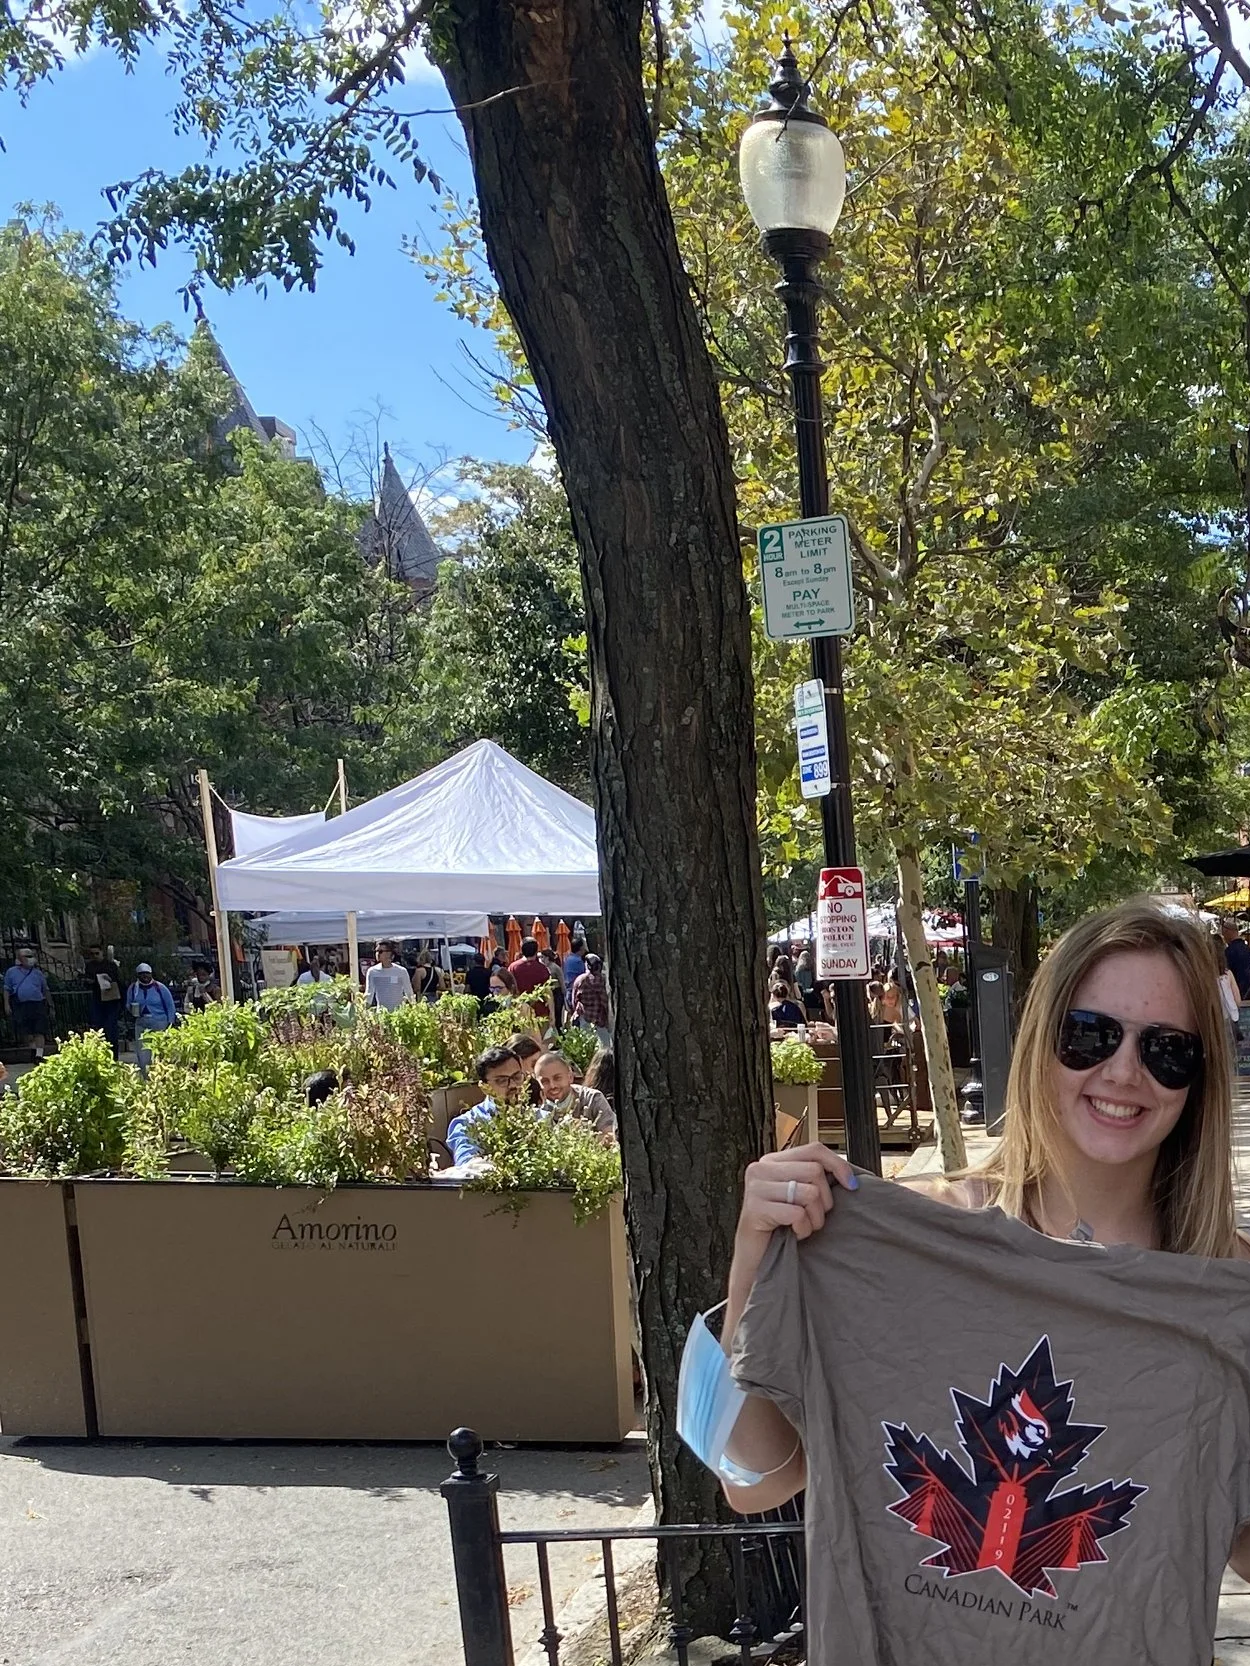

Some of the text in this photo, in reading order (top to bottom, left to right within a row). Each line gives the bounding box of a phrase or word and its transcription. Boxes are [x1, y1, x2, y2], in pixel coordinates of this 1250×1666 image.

[788, 525, 838, 539] PARKING
[763, 529, 781, 554] 2
[794, 536, 833, 549] METER
[763, 552, 784, 562] HOUR
[800, 547, 829, 559] LIMIT
[792, 588, 821, 602] PAY
[781, 610, 805, 619] METER
[817, 607, 836, 615] PARK
[813, 760, 828, 779] 899
[827, 902, 843, 914] NO
[820, 914, 858, 924] STOPPING
[821, 925, 855, 933] BOSTON
[821, 958, 858, 969] SUNDAY
[272, 1213, 397, 1241] Amorino
[994, 1494, 1015, 1560] 02119
